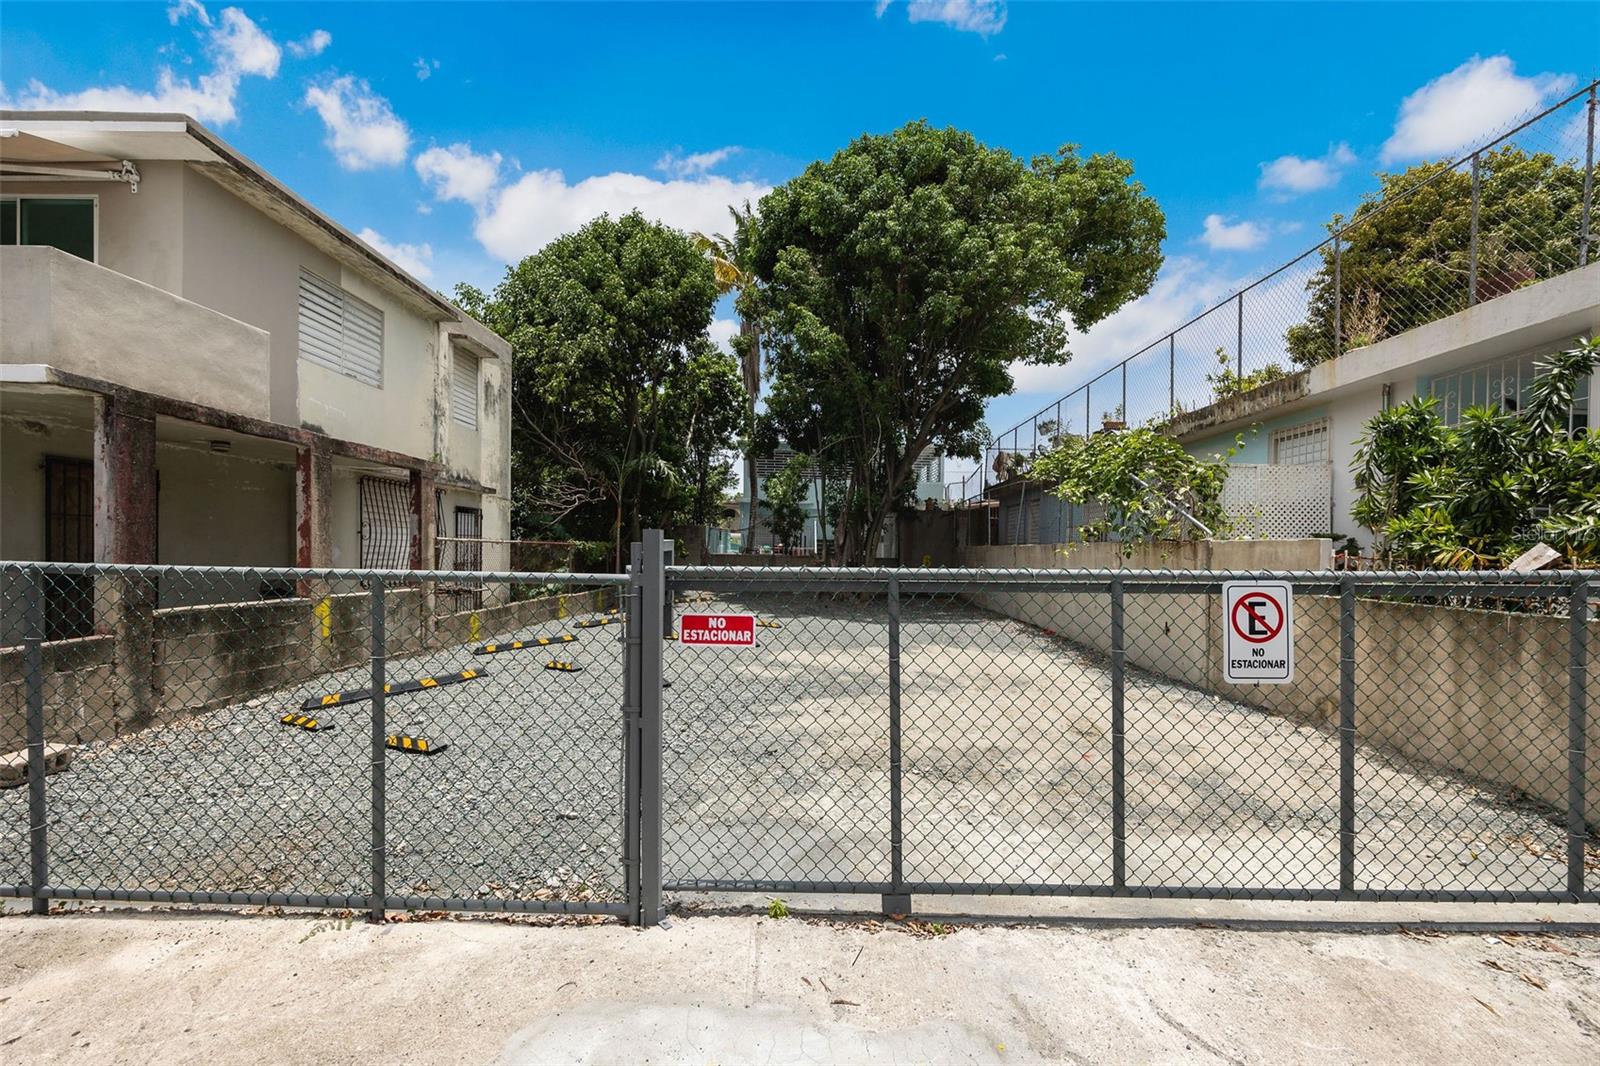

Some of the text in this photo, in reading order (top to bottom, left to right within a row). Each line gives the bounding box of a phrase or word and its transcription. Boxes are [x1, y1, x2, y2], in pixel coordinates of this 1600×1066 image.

[708, 617, 726, 629] NO
[1248, 601, 1268, 635] E
[683, 629, 752, 642] ESTACIONAR
[1252, 648, 1265, 657] NO
[1231, 660, 1286, 669] ESTACIONAR
